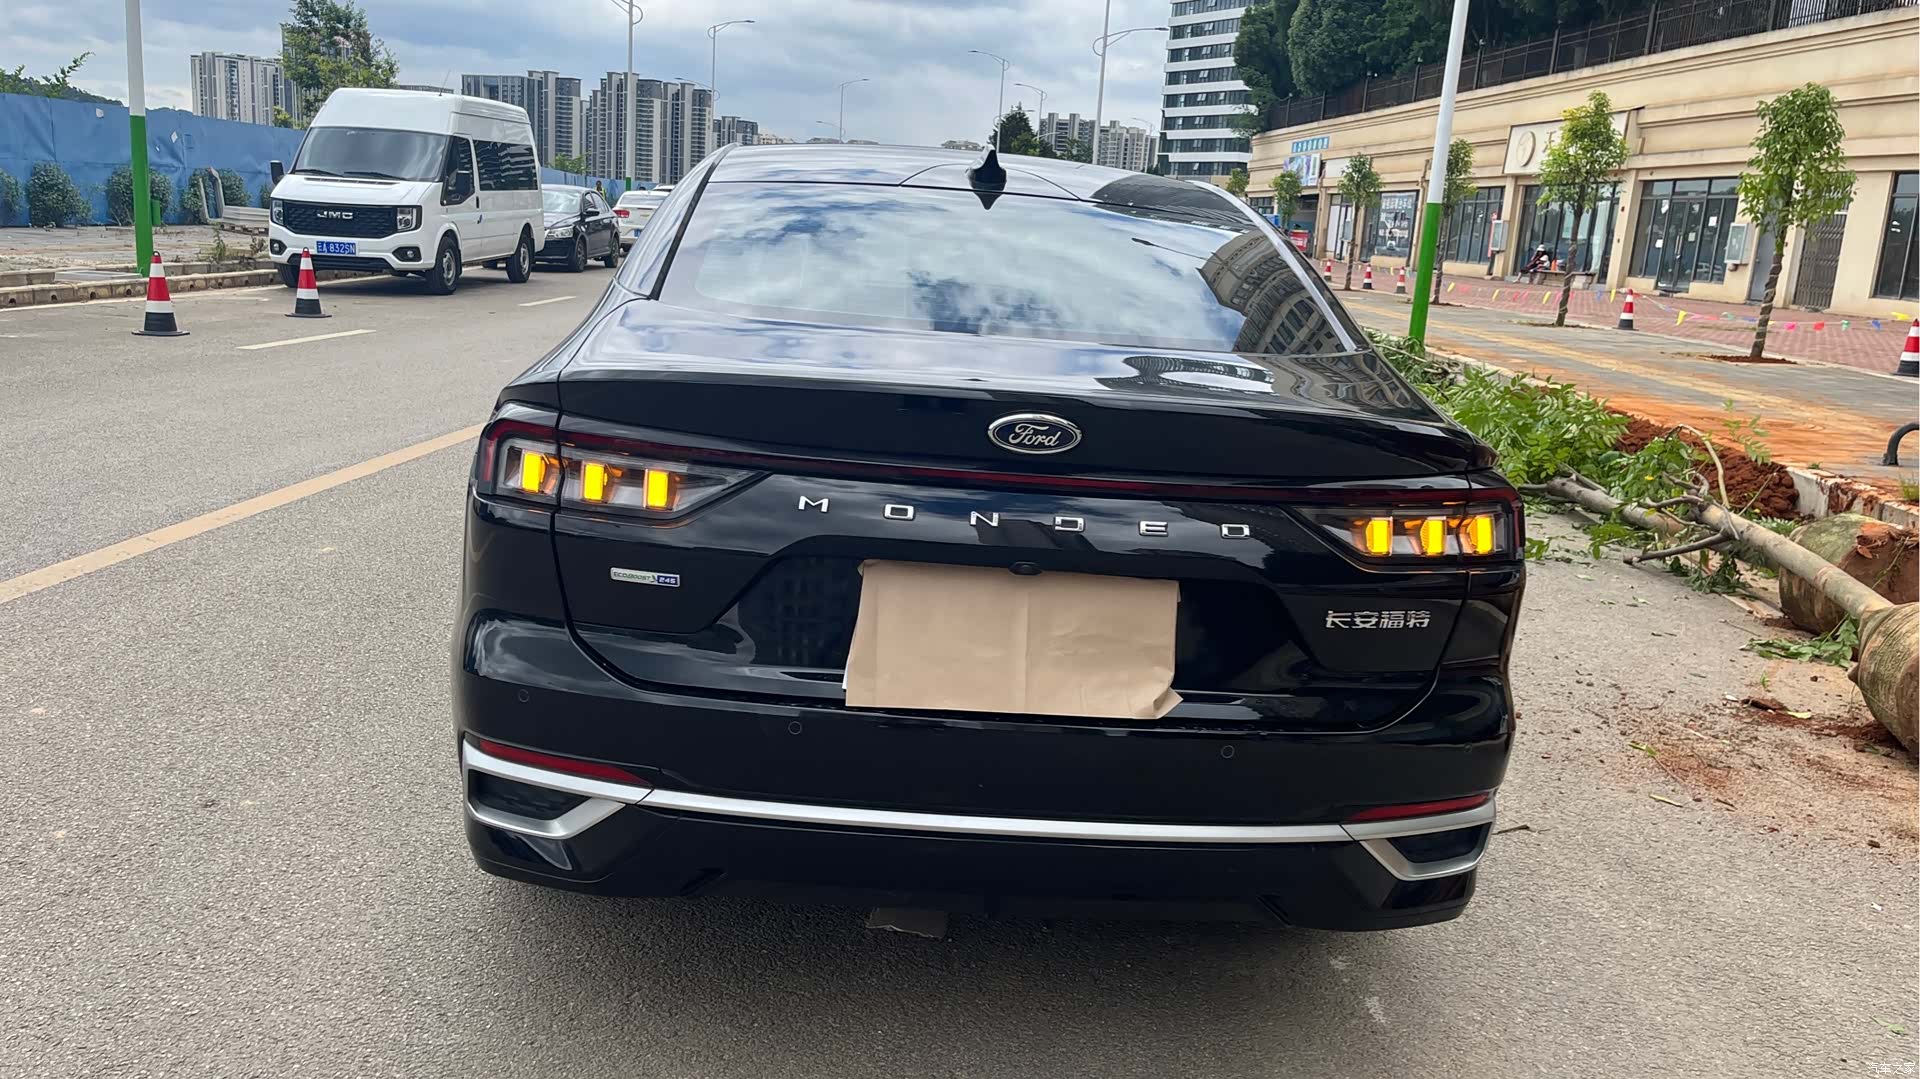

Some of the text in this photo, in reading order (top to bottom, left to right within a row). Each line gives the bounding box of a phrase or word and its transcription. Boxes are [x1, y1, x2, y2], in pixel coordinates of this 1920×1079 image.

[317, 211, 353, 219] JMC
[1009, 423, 1061, 447] Ford
[798, 495, 1250, 539] MONDEO
[658, 576, 676, 584] 245
[1326, 610, 1431, 629] 长安福特
